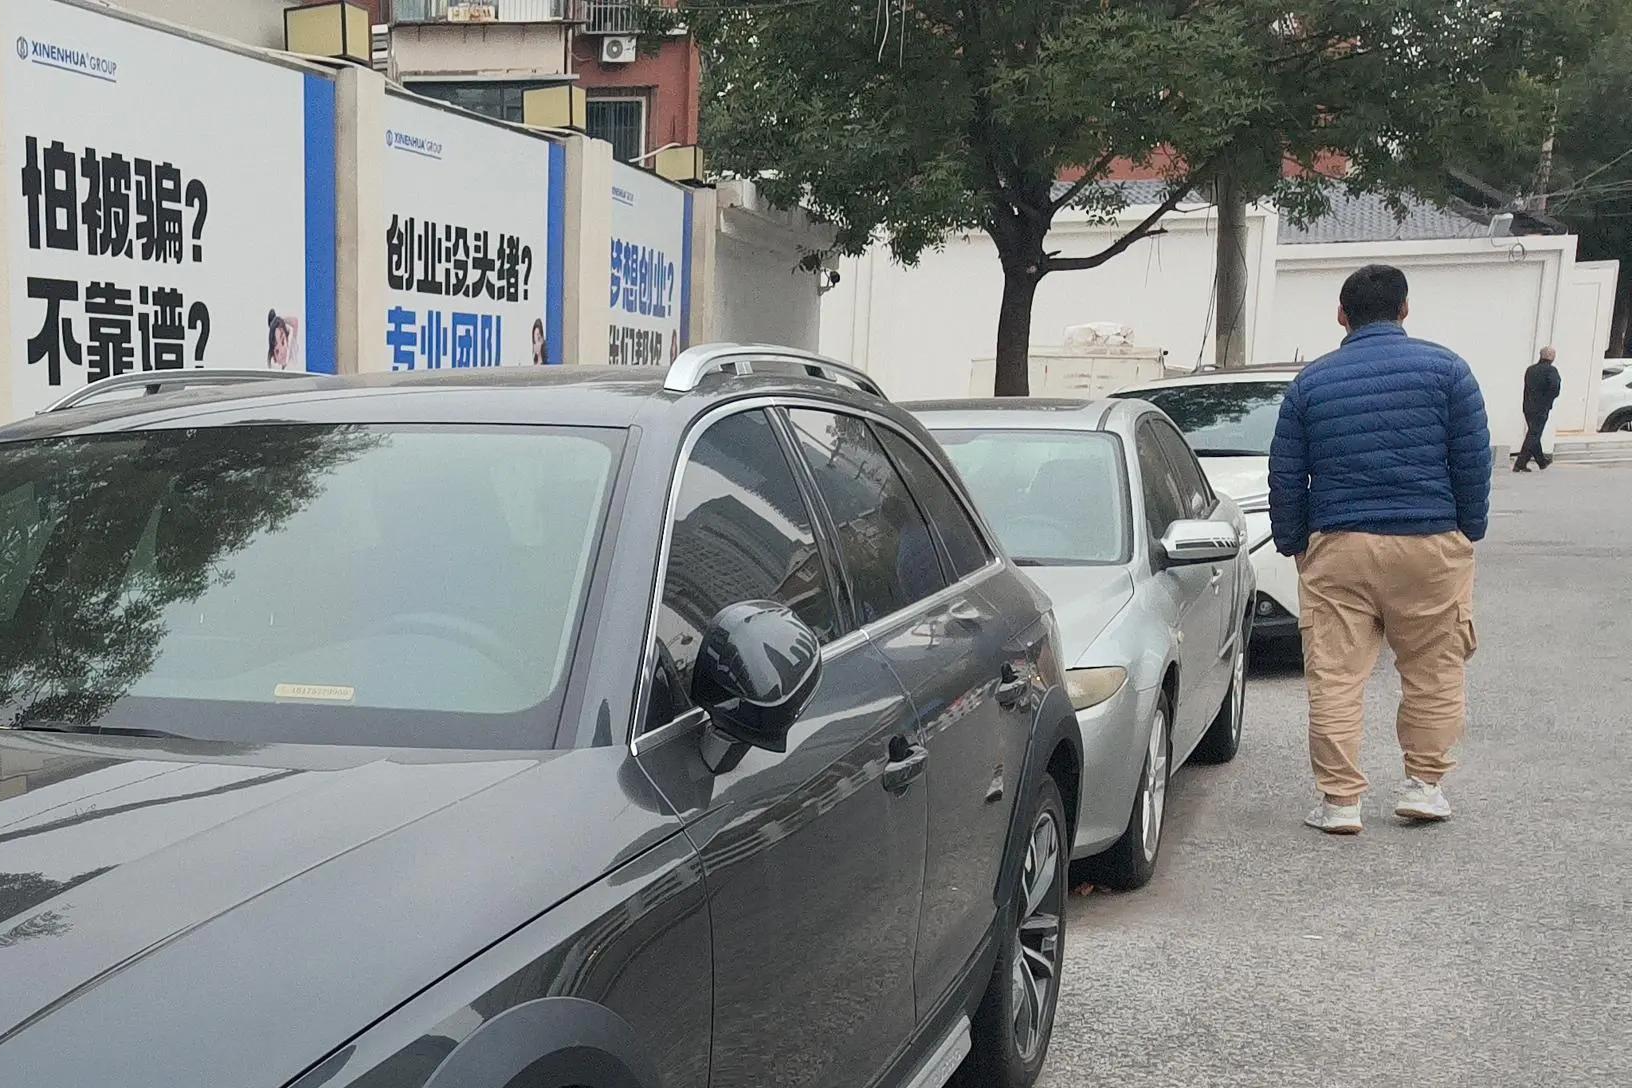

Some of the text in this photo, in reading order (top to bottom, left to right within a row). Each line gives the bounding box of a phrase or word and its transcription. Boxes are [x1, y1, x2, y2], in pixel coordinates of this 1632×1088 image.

[31, 40, 117, 76] XINENHUA GROUP
[21, 135, 208, 264] 怕被骗?
[386, 213, 533, 302] 创业没头绪?
[609, 237, 675, 318] 梦想创业?
[26, 276, 211, 386] 不靠谱?
[386, 305, 502, 372] 专业团队
